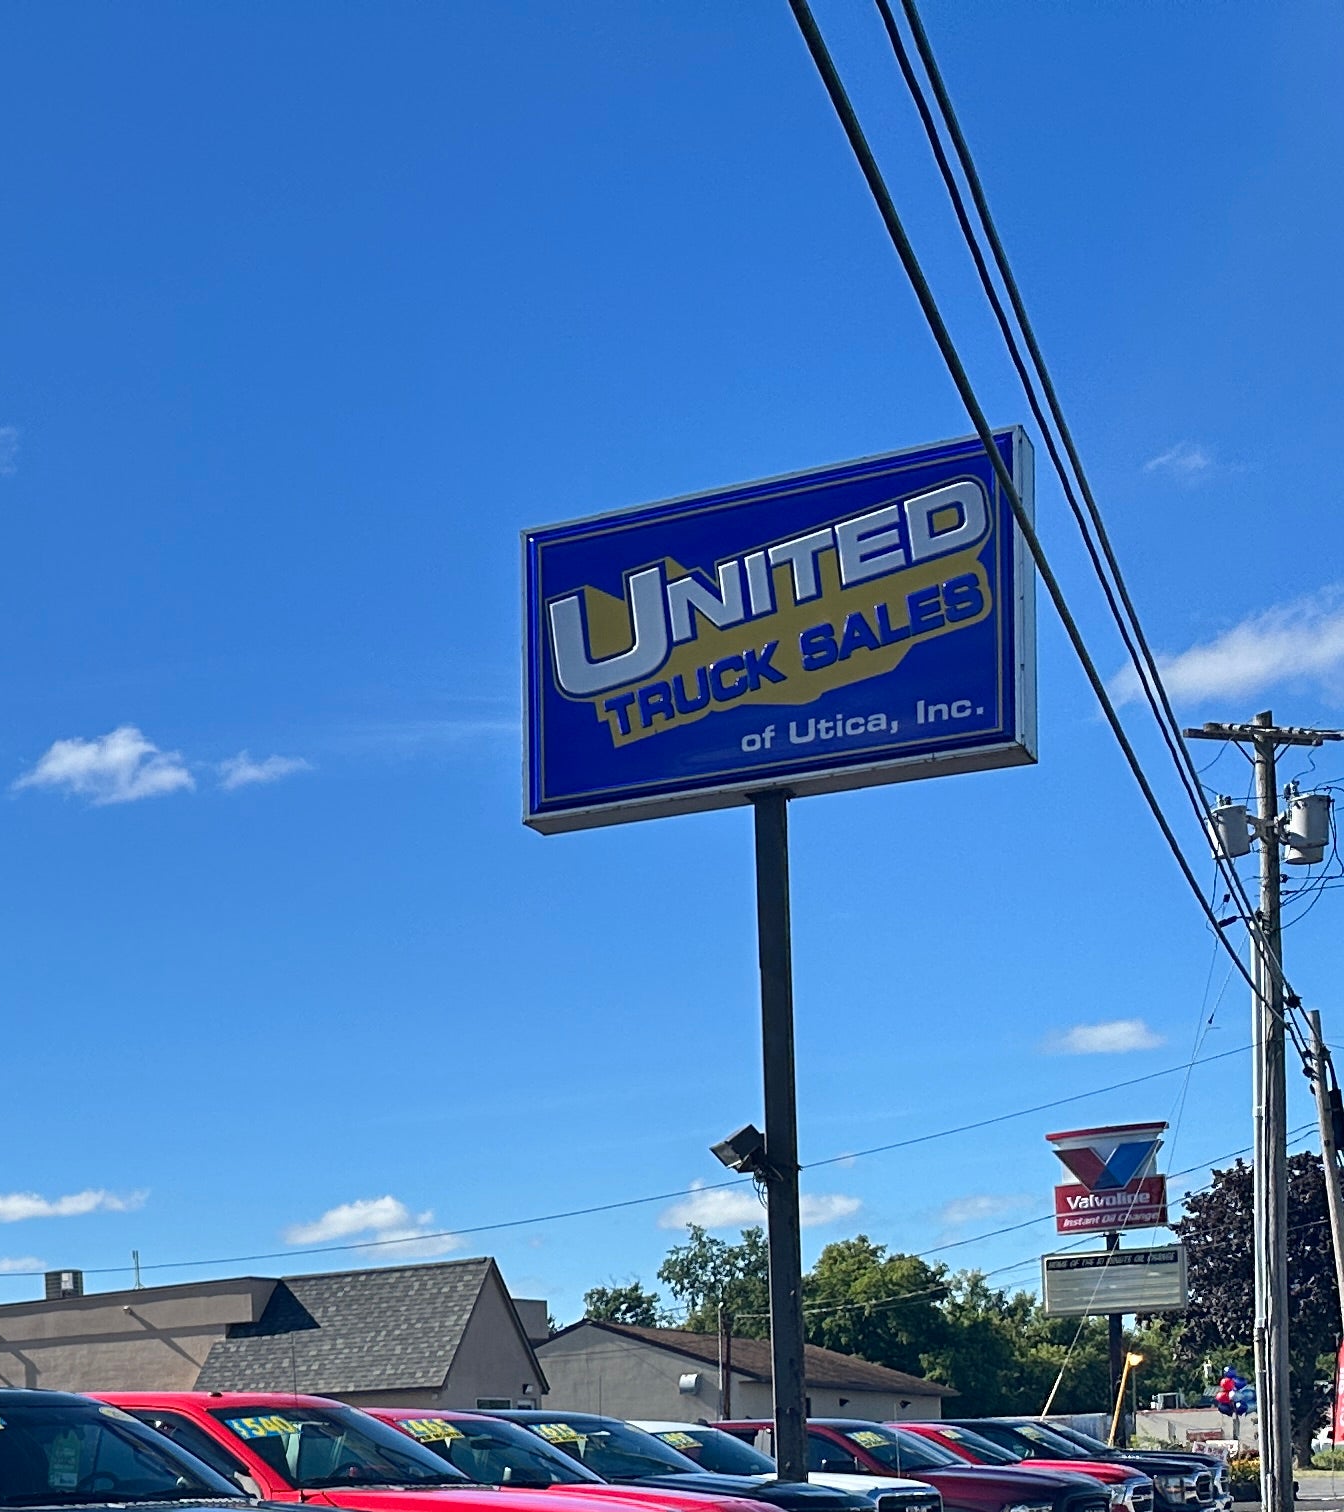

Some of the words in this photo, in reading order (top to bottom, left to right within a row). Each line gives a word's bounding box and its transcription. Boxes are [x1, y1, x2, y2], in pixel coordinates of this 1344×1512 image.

[548, 480, 989, 696] UNITED
[605, 642, 786, 736] TRUCK
[799, 572, 984, 671] SALES
[741, 724, 776, 753] of
[789, 710, 899, 745] Utica,
[916, 695, 985, 726] Inc.
[1063, 1216, 1100, 1228] Instant
[1102, 1214, 1116, 1224] Oil
[1066, 1191, 1151, 1210] Valvoline
